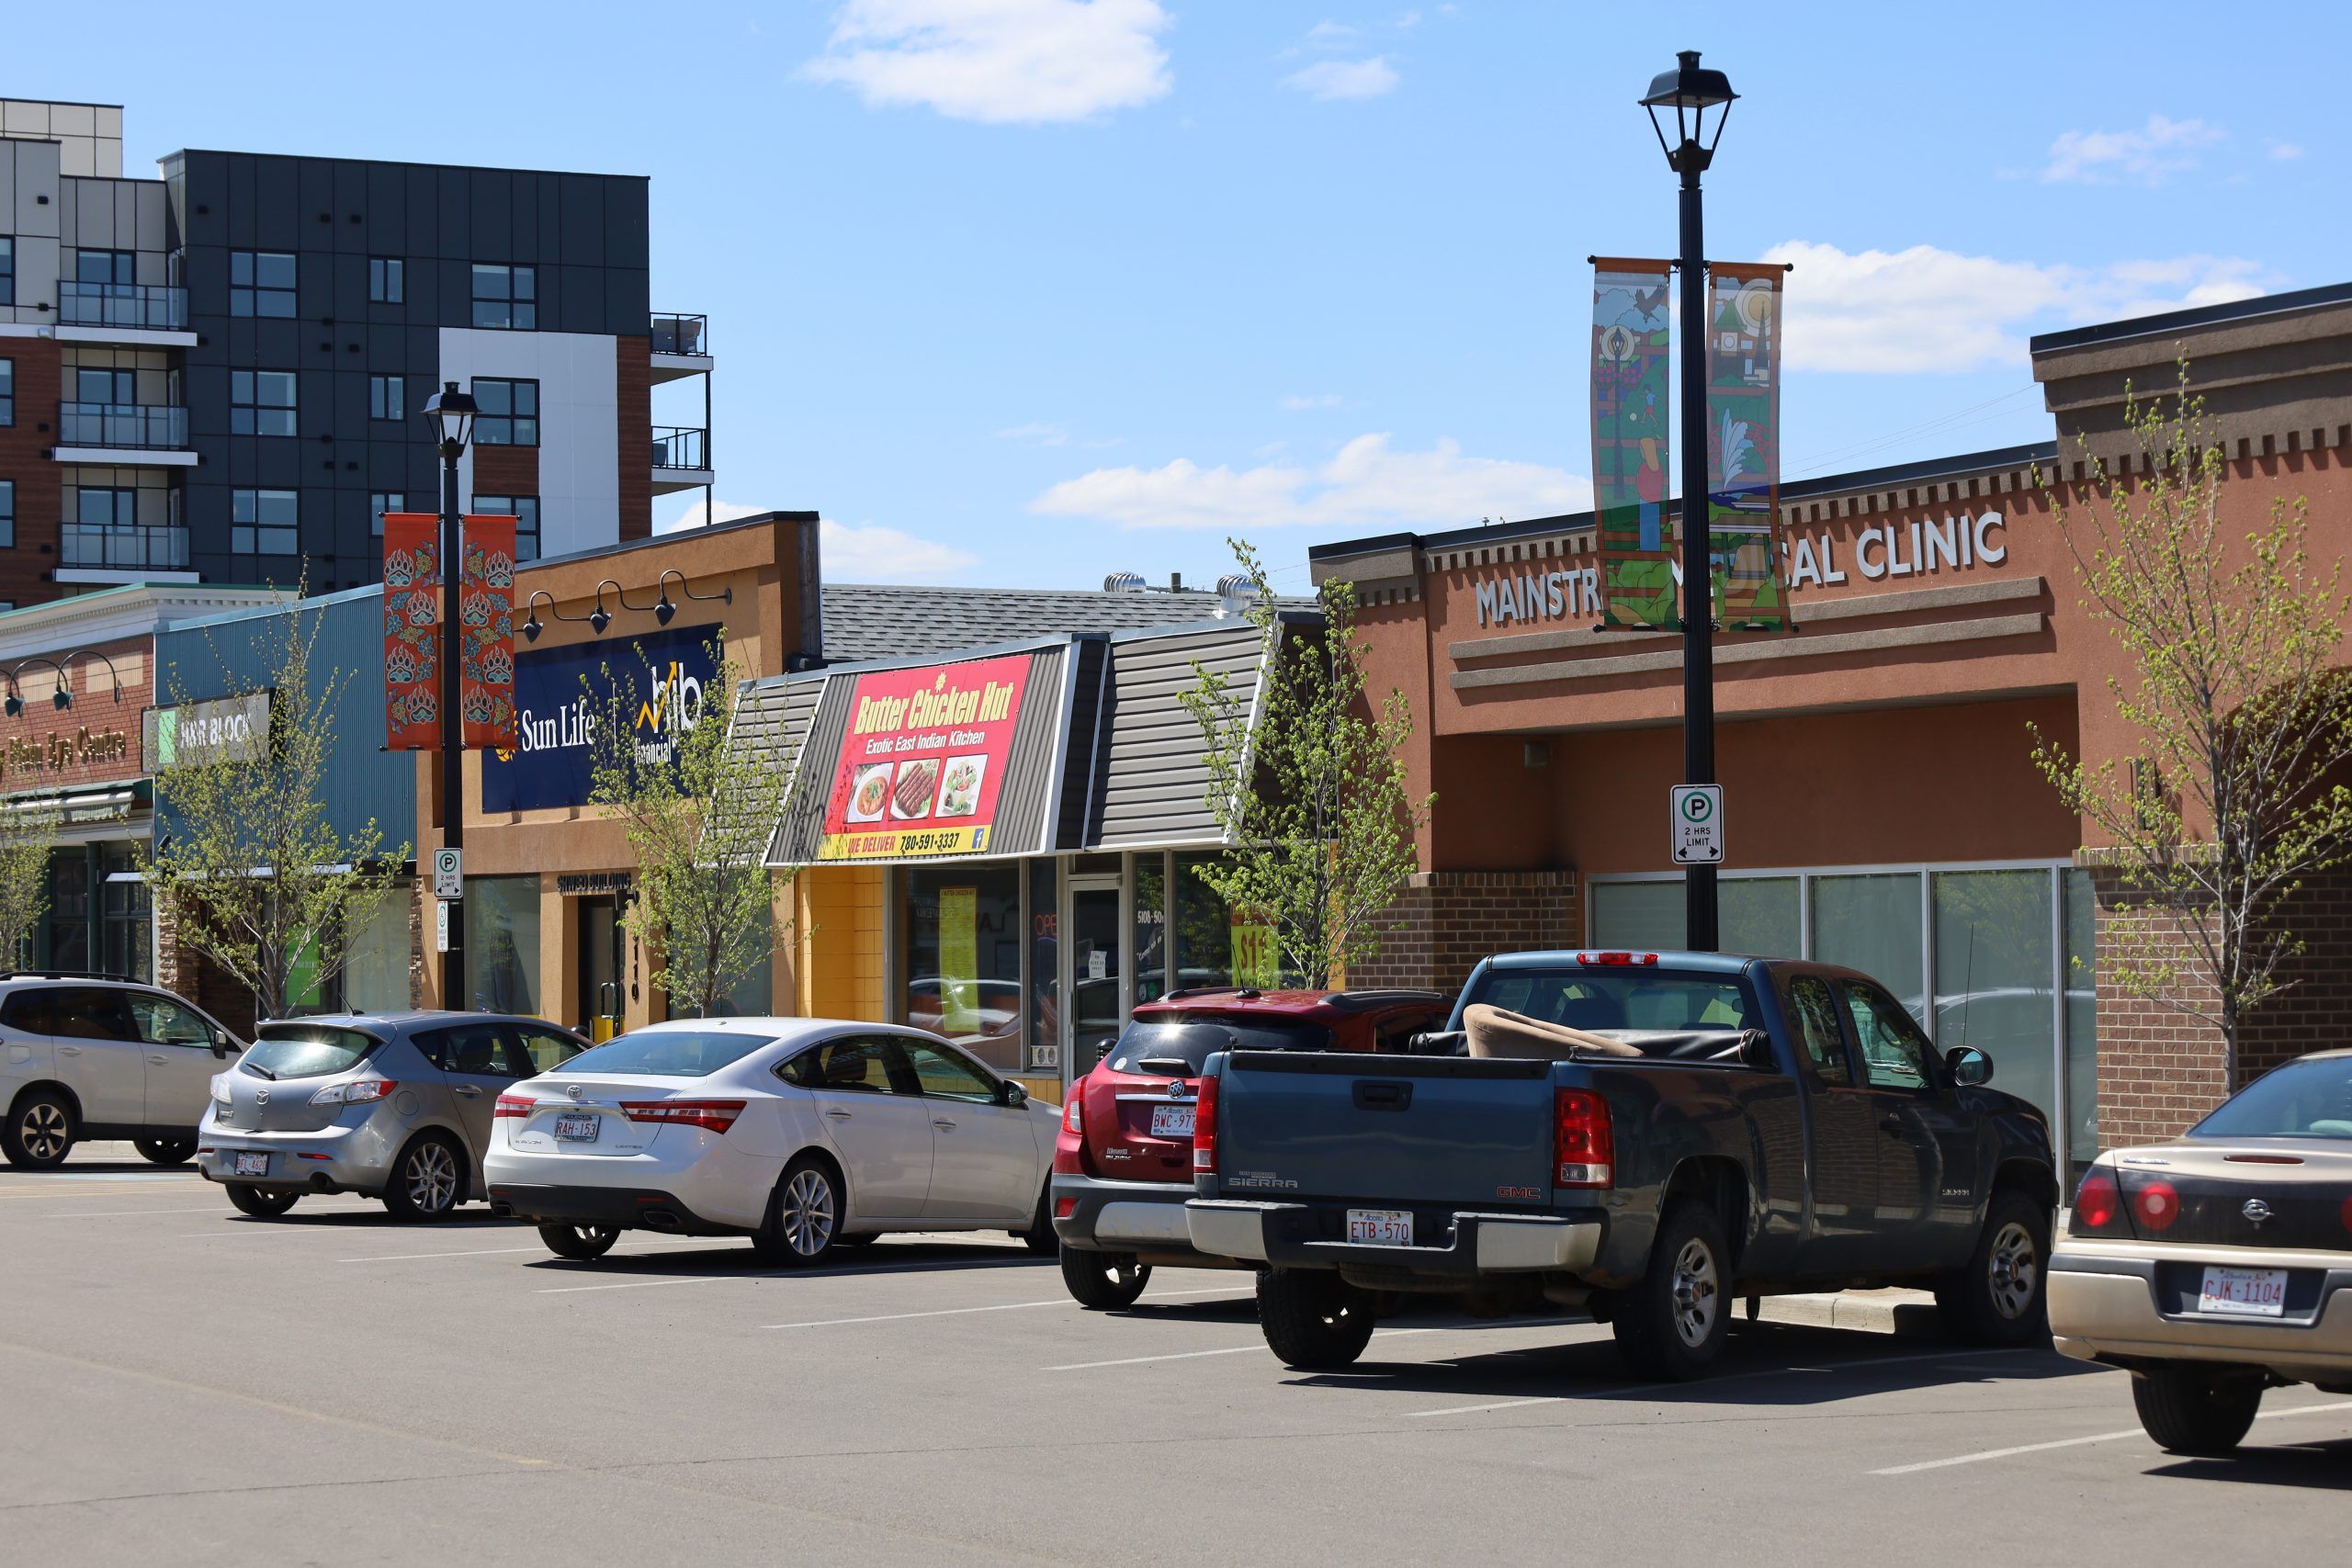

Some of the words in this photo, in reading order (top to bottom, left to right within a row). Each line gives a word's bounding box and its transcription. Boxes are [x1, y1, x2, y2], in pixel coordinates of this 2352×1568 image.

[1476, 568, 1603, 625] MAINSTR
[1855, 511, 2006, 580] CLINIC
[854, 695, 910, 735] Butter
[907, 685, 980, 730] Chicken
[978, 681, 1014, 724] Hut
[209, 713, 251, 745] BLOCK
[522, 708, 558, 752] Sun
[560, 698, 596, 748] Life
[865, 738, 894, 755] Exotic
[895, 736, 917, 752] East
[917, 732, 946, 750] Indian
[948, 730, 986, 748] Kitchen
[1684, 827, 1690, 836] 2
[1693, 827, 1711, 836] HRS
[847, 837, 862, 853] WE
[862, 835, 896, 853] DELIVER
[1686, 837, 1710, 847] LIMIT
[588, 872, 631, 891] BUILDING
[1035, 915, 1057, 936] OPE
[557, 1122, 595, 1135] RAH-153
[1154, 1114, 1196, 1129] BWC-977
[1228, 1177, 1298, 1188] SIERRA
[1497, 1186, 1541, 1200] GMC
[1351, 1221, 1409, 1240] ETB-570
[2204, 1279, 2282, 1303] CJK-1104
